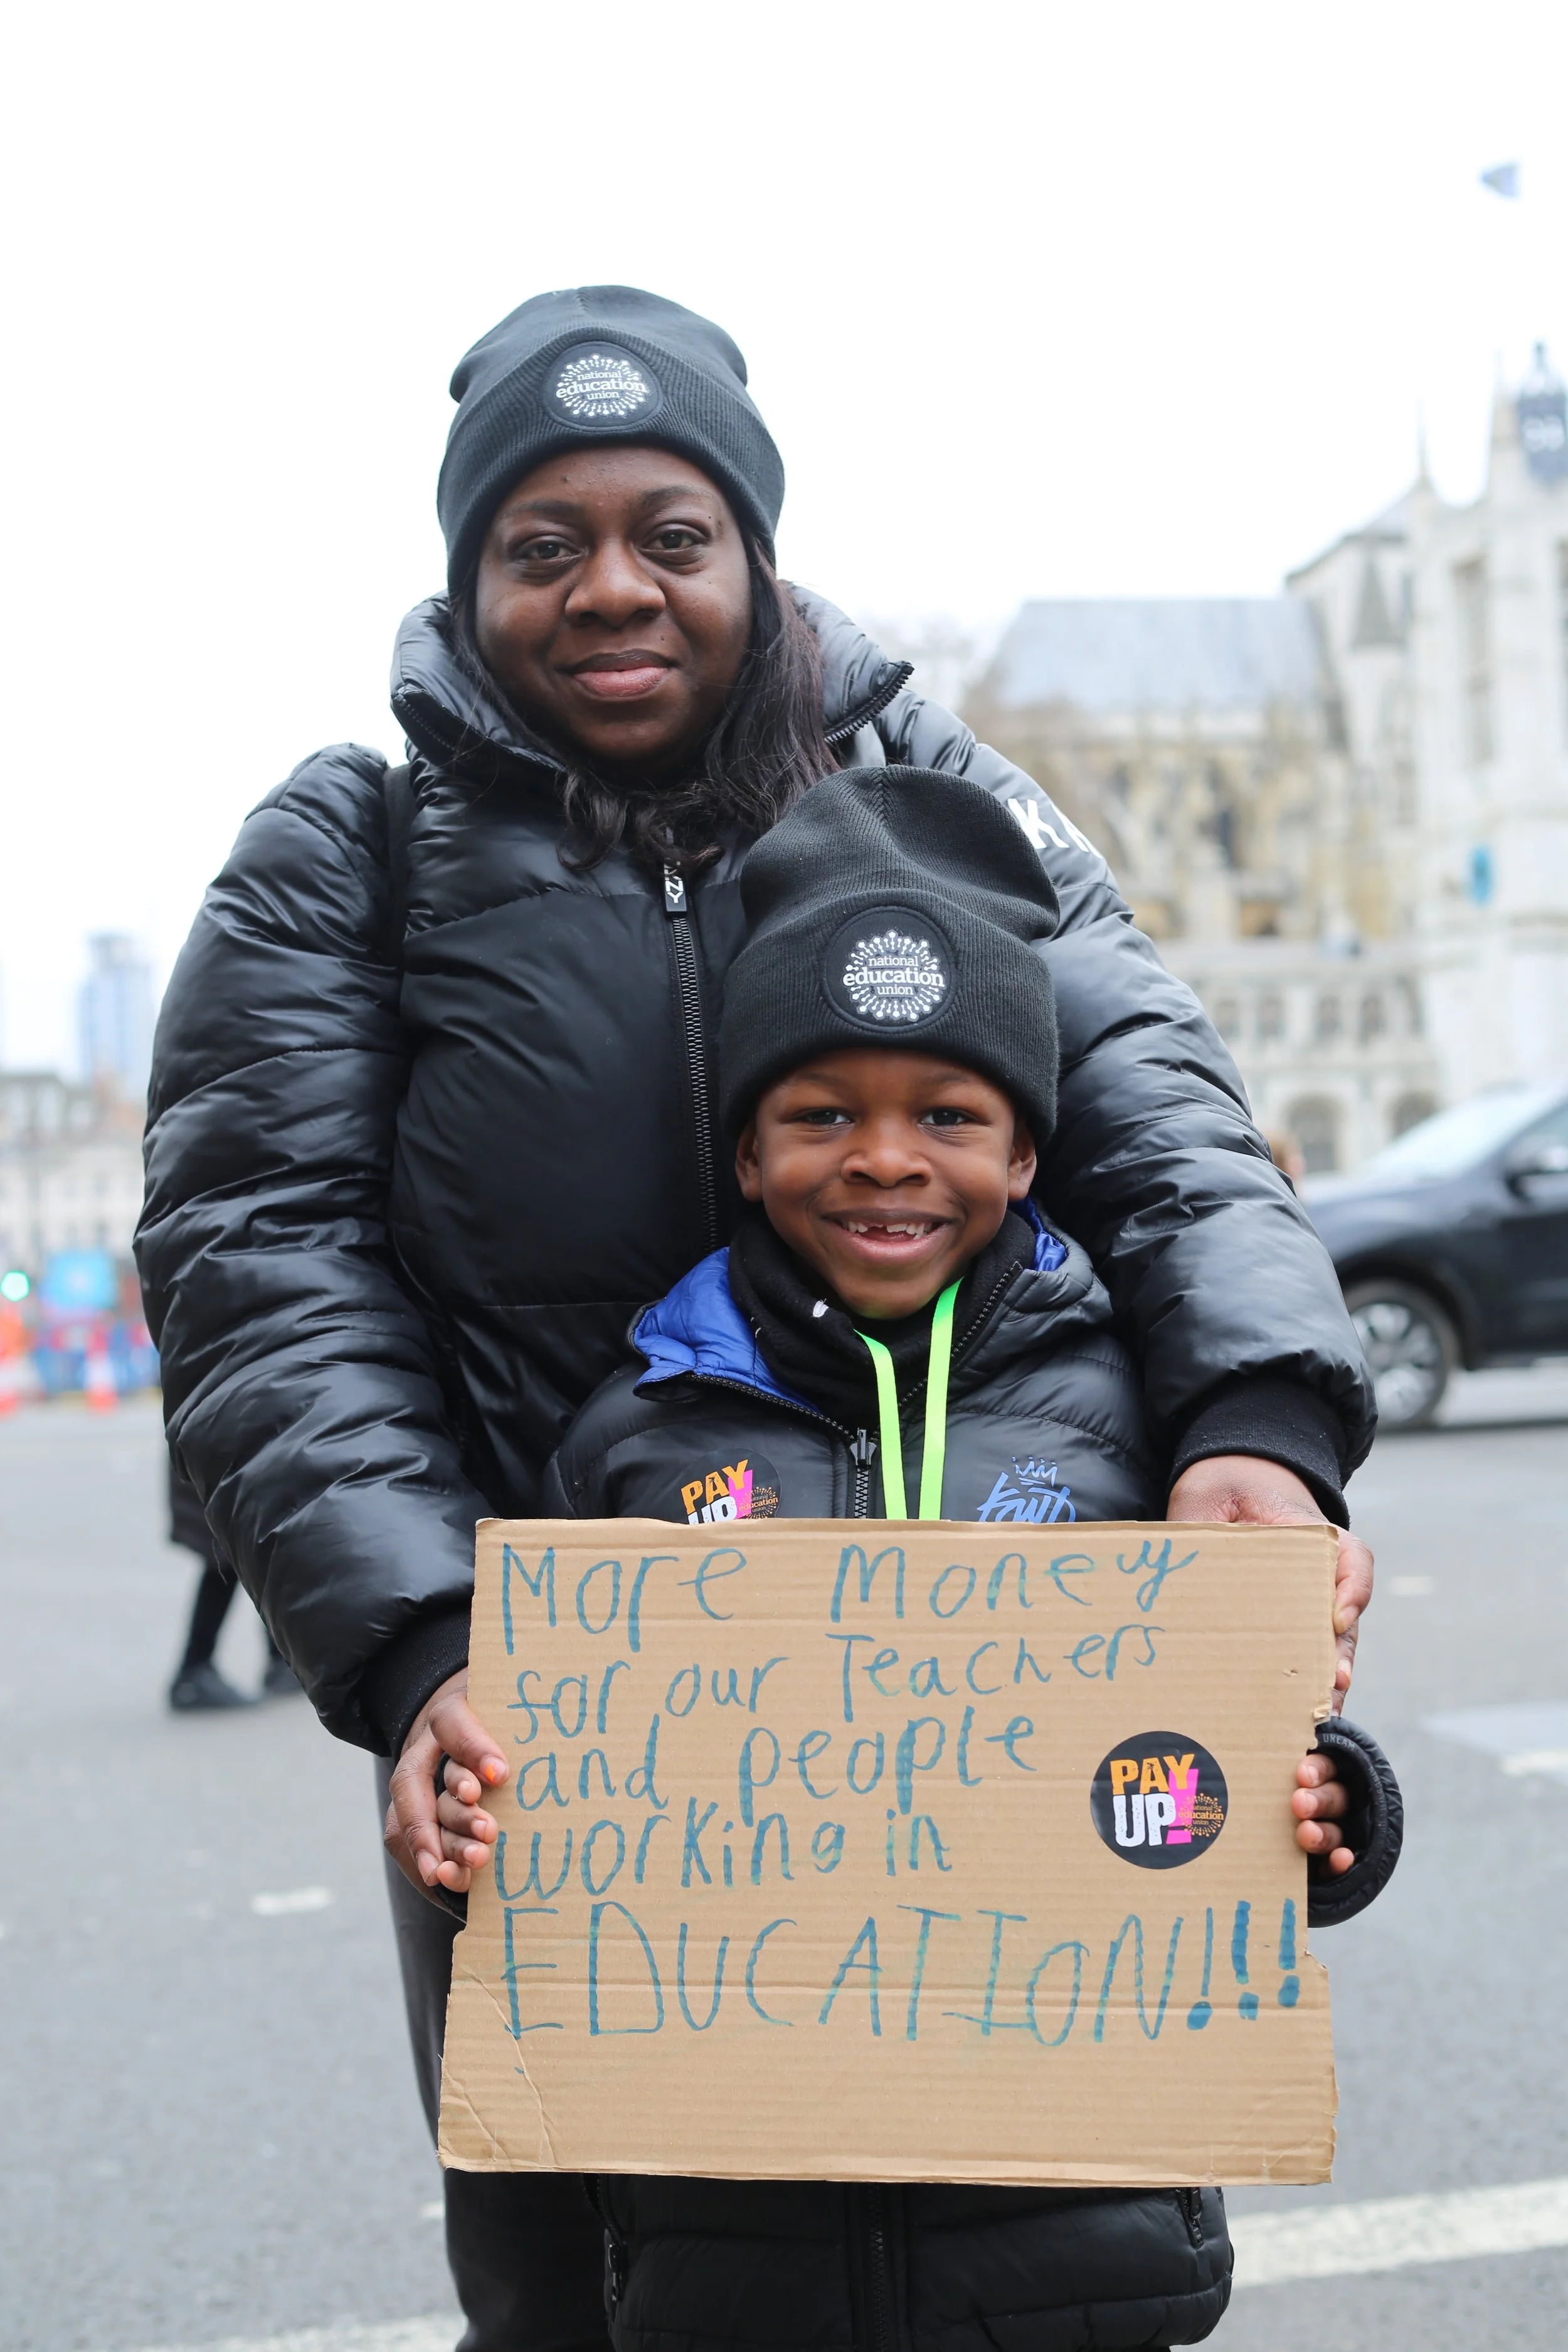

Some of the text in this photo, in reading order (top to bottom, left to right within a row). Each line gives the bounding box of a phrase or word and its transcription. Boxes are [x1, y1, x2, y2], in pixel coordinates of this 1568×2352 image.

[577, 371, 622, 381] national
[556, 378, 649, 398] education
[586, 391, 620, 400] union
[868, 955, 919, 967] national
[842, 967, 945, 987] education
[877, 984, 914, 995] union
[681, 1459, 748, 1515] PAY
[502, 1538, 1199, 1655] More Money
[507, 1624, 1165, 1744] for our Teachers
[1323, 1733, 1355, 1751] DREAM
[516, 1705, 1037, 1828] and people
[1110, 1754, 1195, 1795] PAY
[1179, 1811, 1224, 1820] education
[494, 1796, 953, 1901] working in
